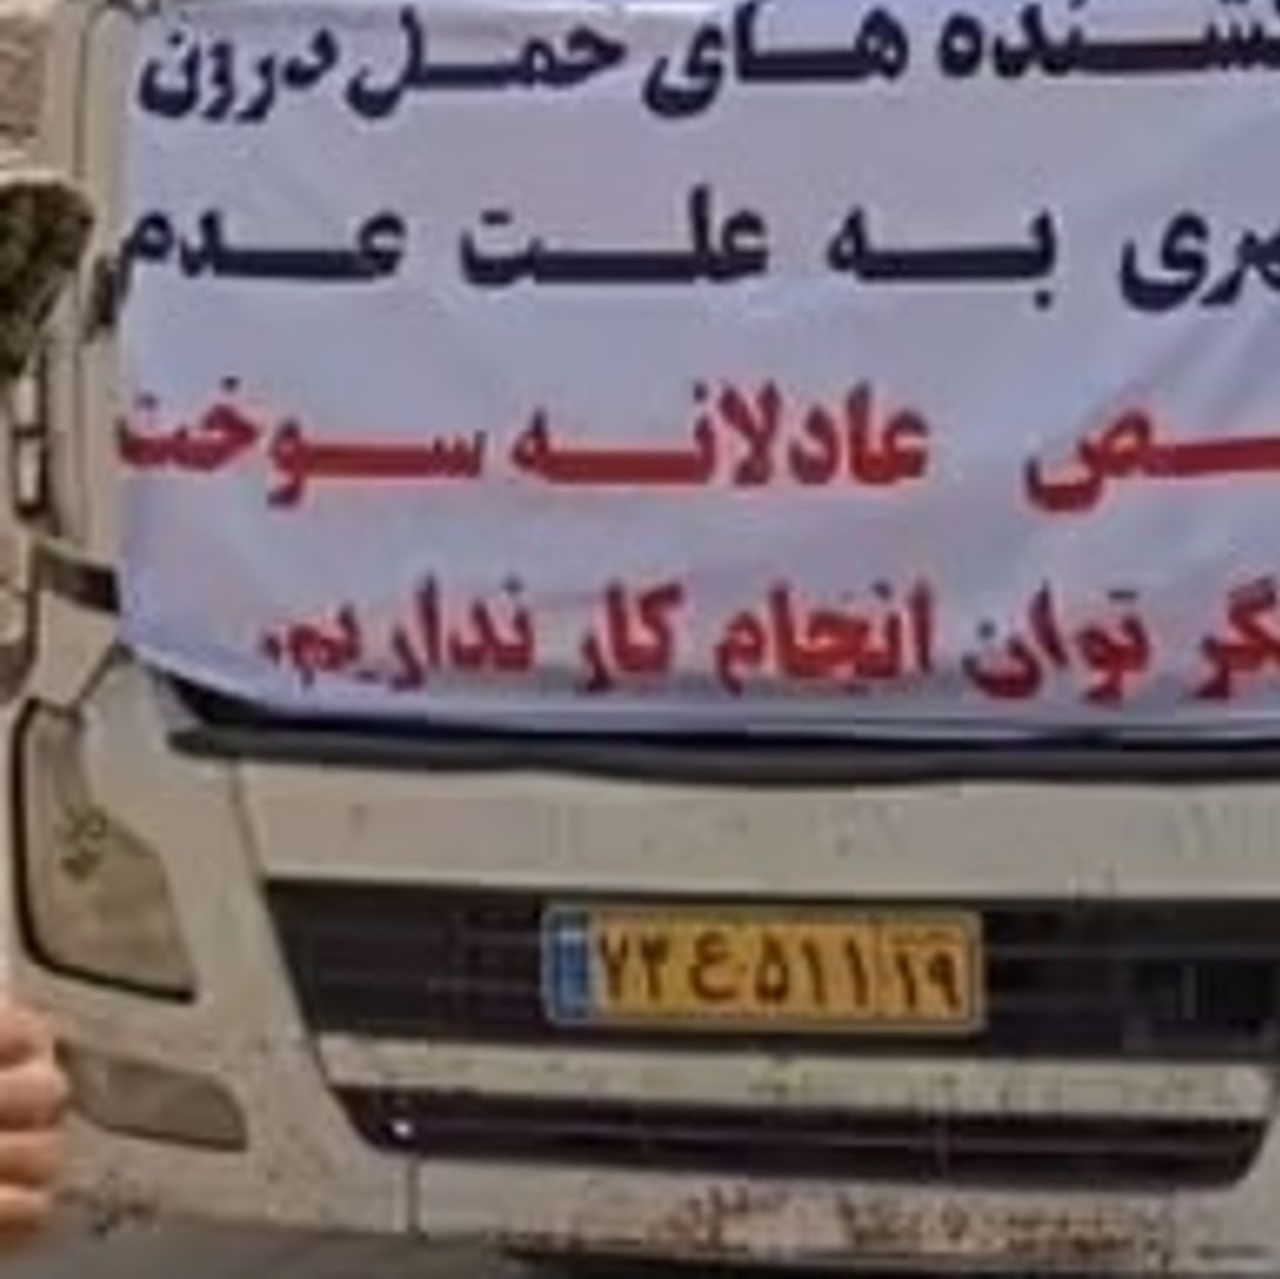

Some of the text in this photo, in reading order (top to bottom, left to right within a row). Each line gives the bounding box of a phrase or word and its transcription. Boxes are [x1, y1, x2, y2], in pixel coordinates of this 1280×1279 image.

[137, 27, 338, 122] درون
[346, 5, 627, 119] حمل
[118, 209, 407, 304] عدم
[458, 184, 769, 288] علت
[826, 205, 1058, 309] به
[114, 376, 486, 509] سوخت
[509, 381, 929, 487] عادلانه
[578, 579, 686, 694] کار
[712, 579, 937, 696] انجام
[960, 583, 1153, 706] توان
